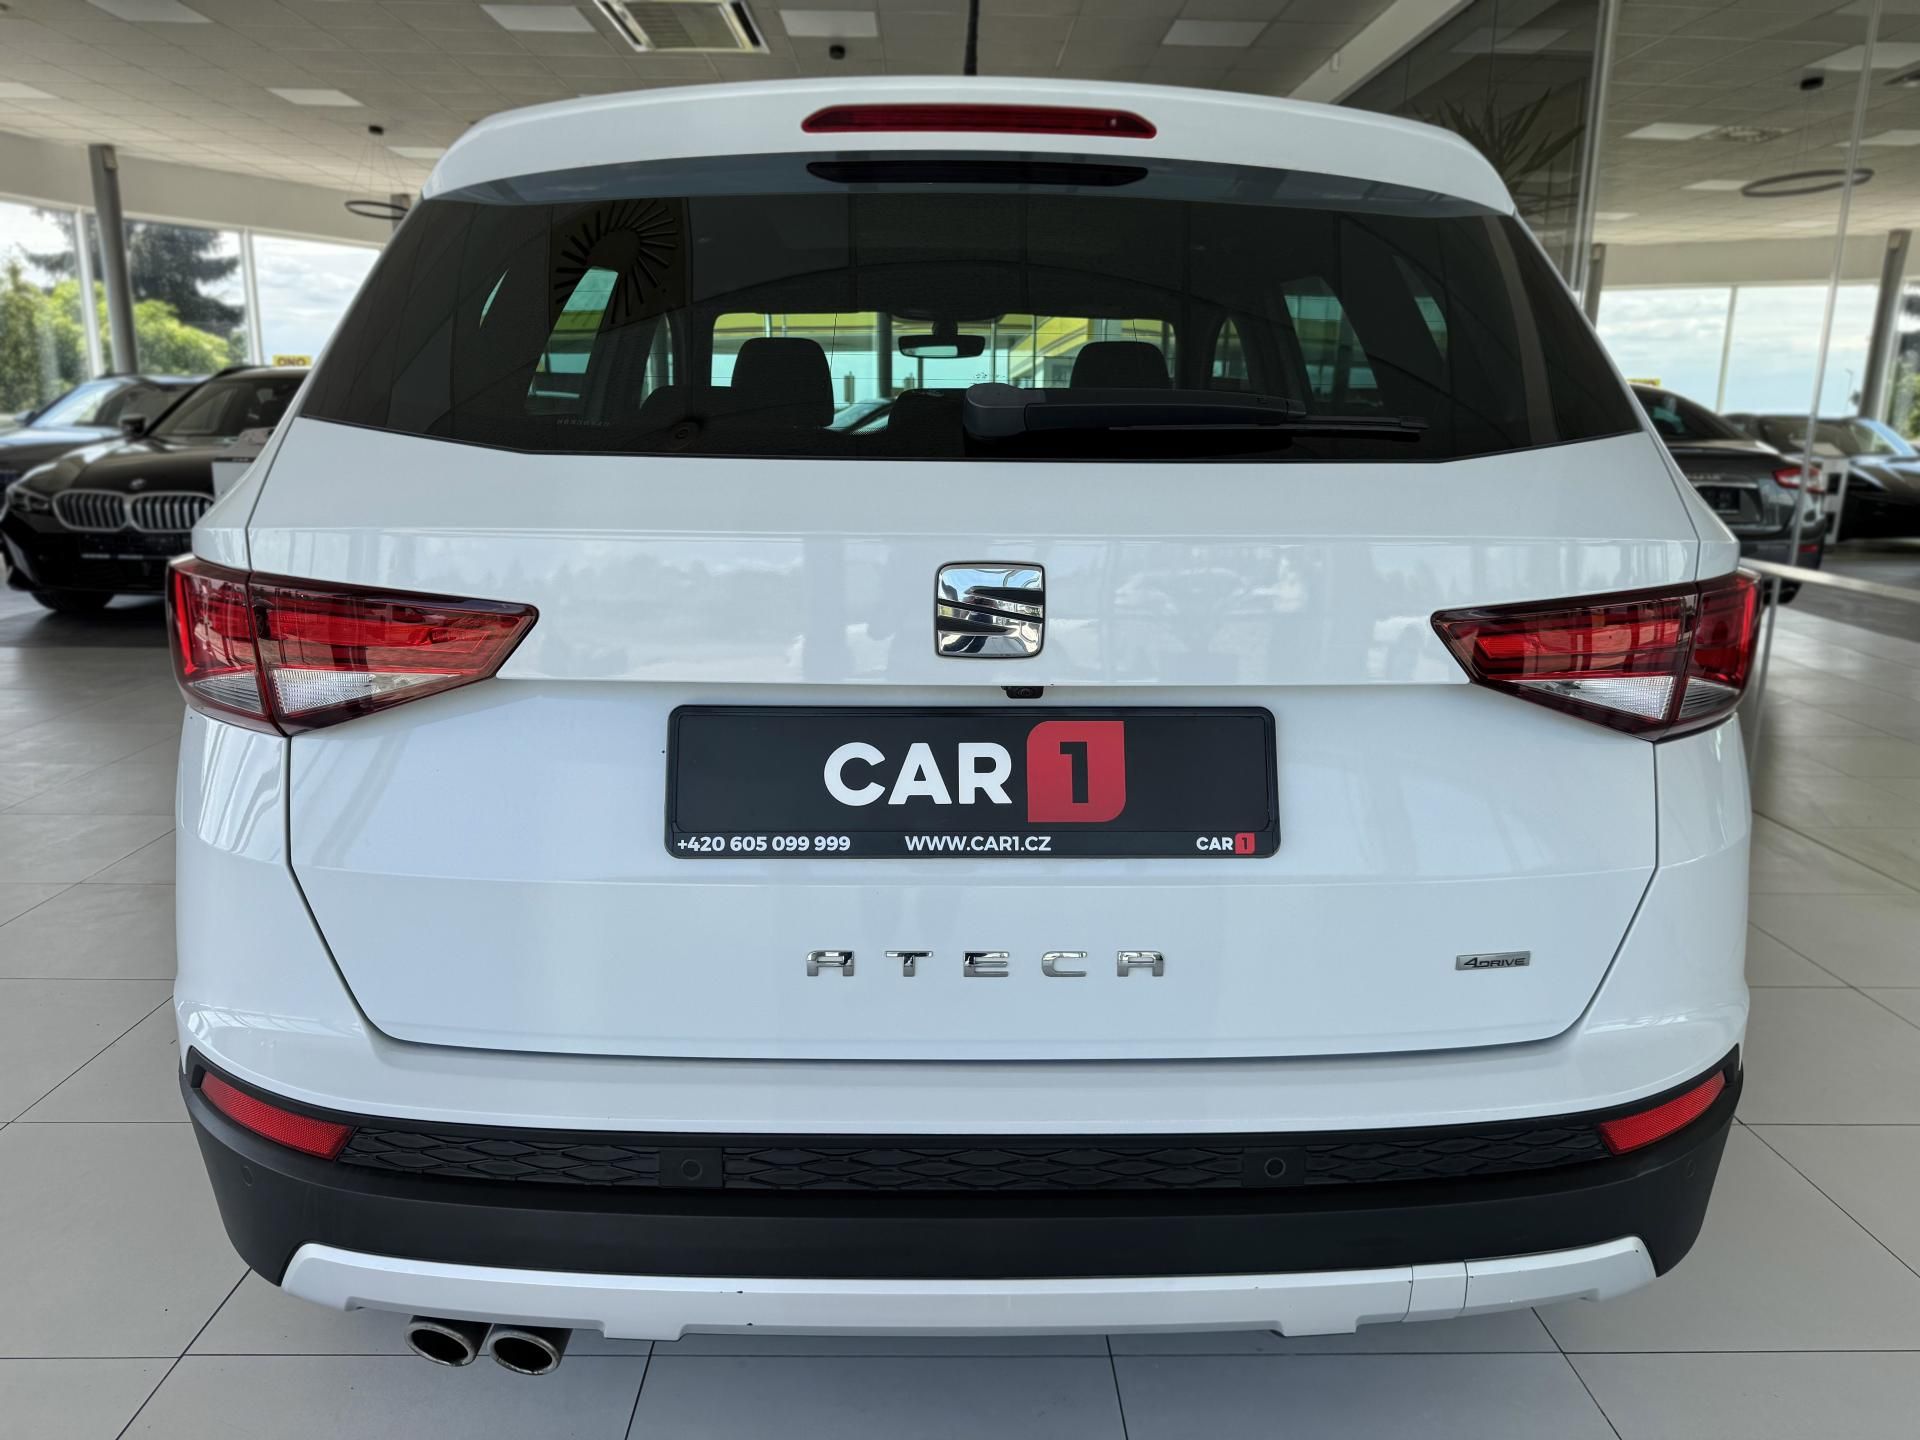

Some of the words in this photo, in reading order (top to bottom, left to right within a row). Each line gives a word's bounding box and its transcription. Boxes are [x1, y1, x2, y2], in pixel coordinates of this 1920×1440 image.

[823, 741, 1013, 807] CAR
[677, 836, 726, 852] +420
[729, 836, 768, 851] 605
[771, 836, 810, 851] 099
[814, 836, 851, 851] 999
[904, 835, 1052, 851] WWW.CAR1.CZ
[1196, 836, 1234, 851] CAR
[806, 950, 1165, 977] ATECA
[1463, 956, 1526, 968] 4DRIVE
